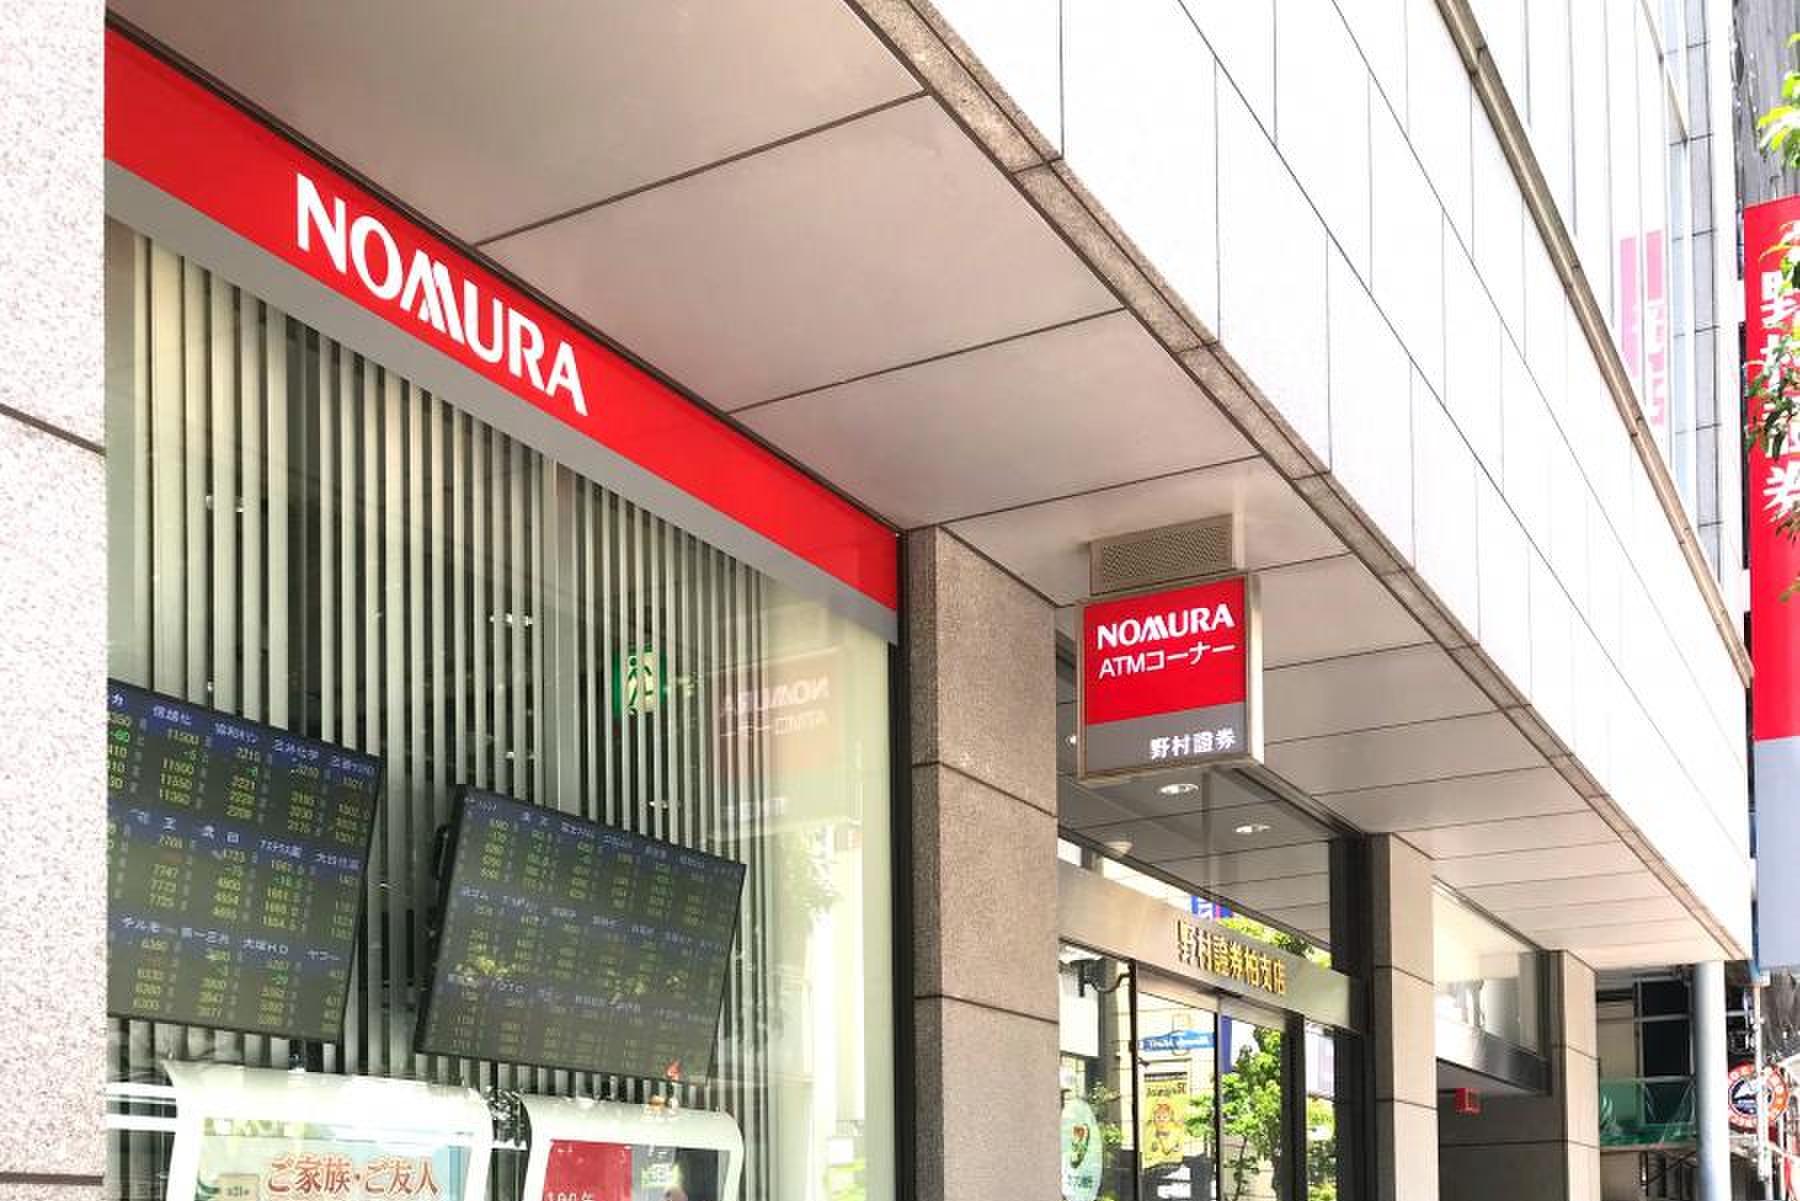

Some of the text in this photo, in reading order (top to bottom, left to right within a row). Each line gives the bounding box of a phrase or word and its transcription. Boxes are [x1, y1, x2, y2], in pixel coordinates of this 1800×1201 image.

[296, 172, 588, 417] NOMURA
[1097, 603, 1235, 650] NOMURA
[1099, 641, 1236, 680] ATMコーナー
[1151, 727, 1236, 760] 野村證券
